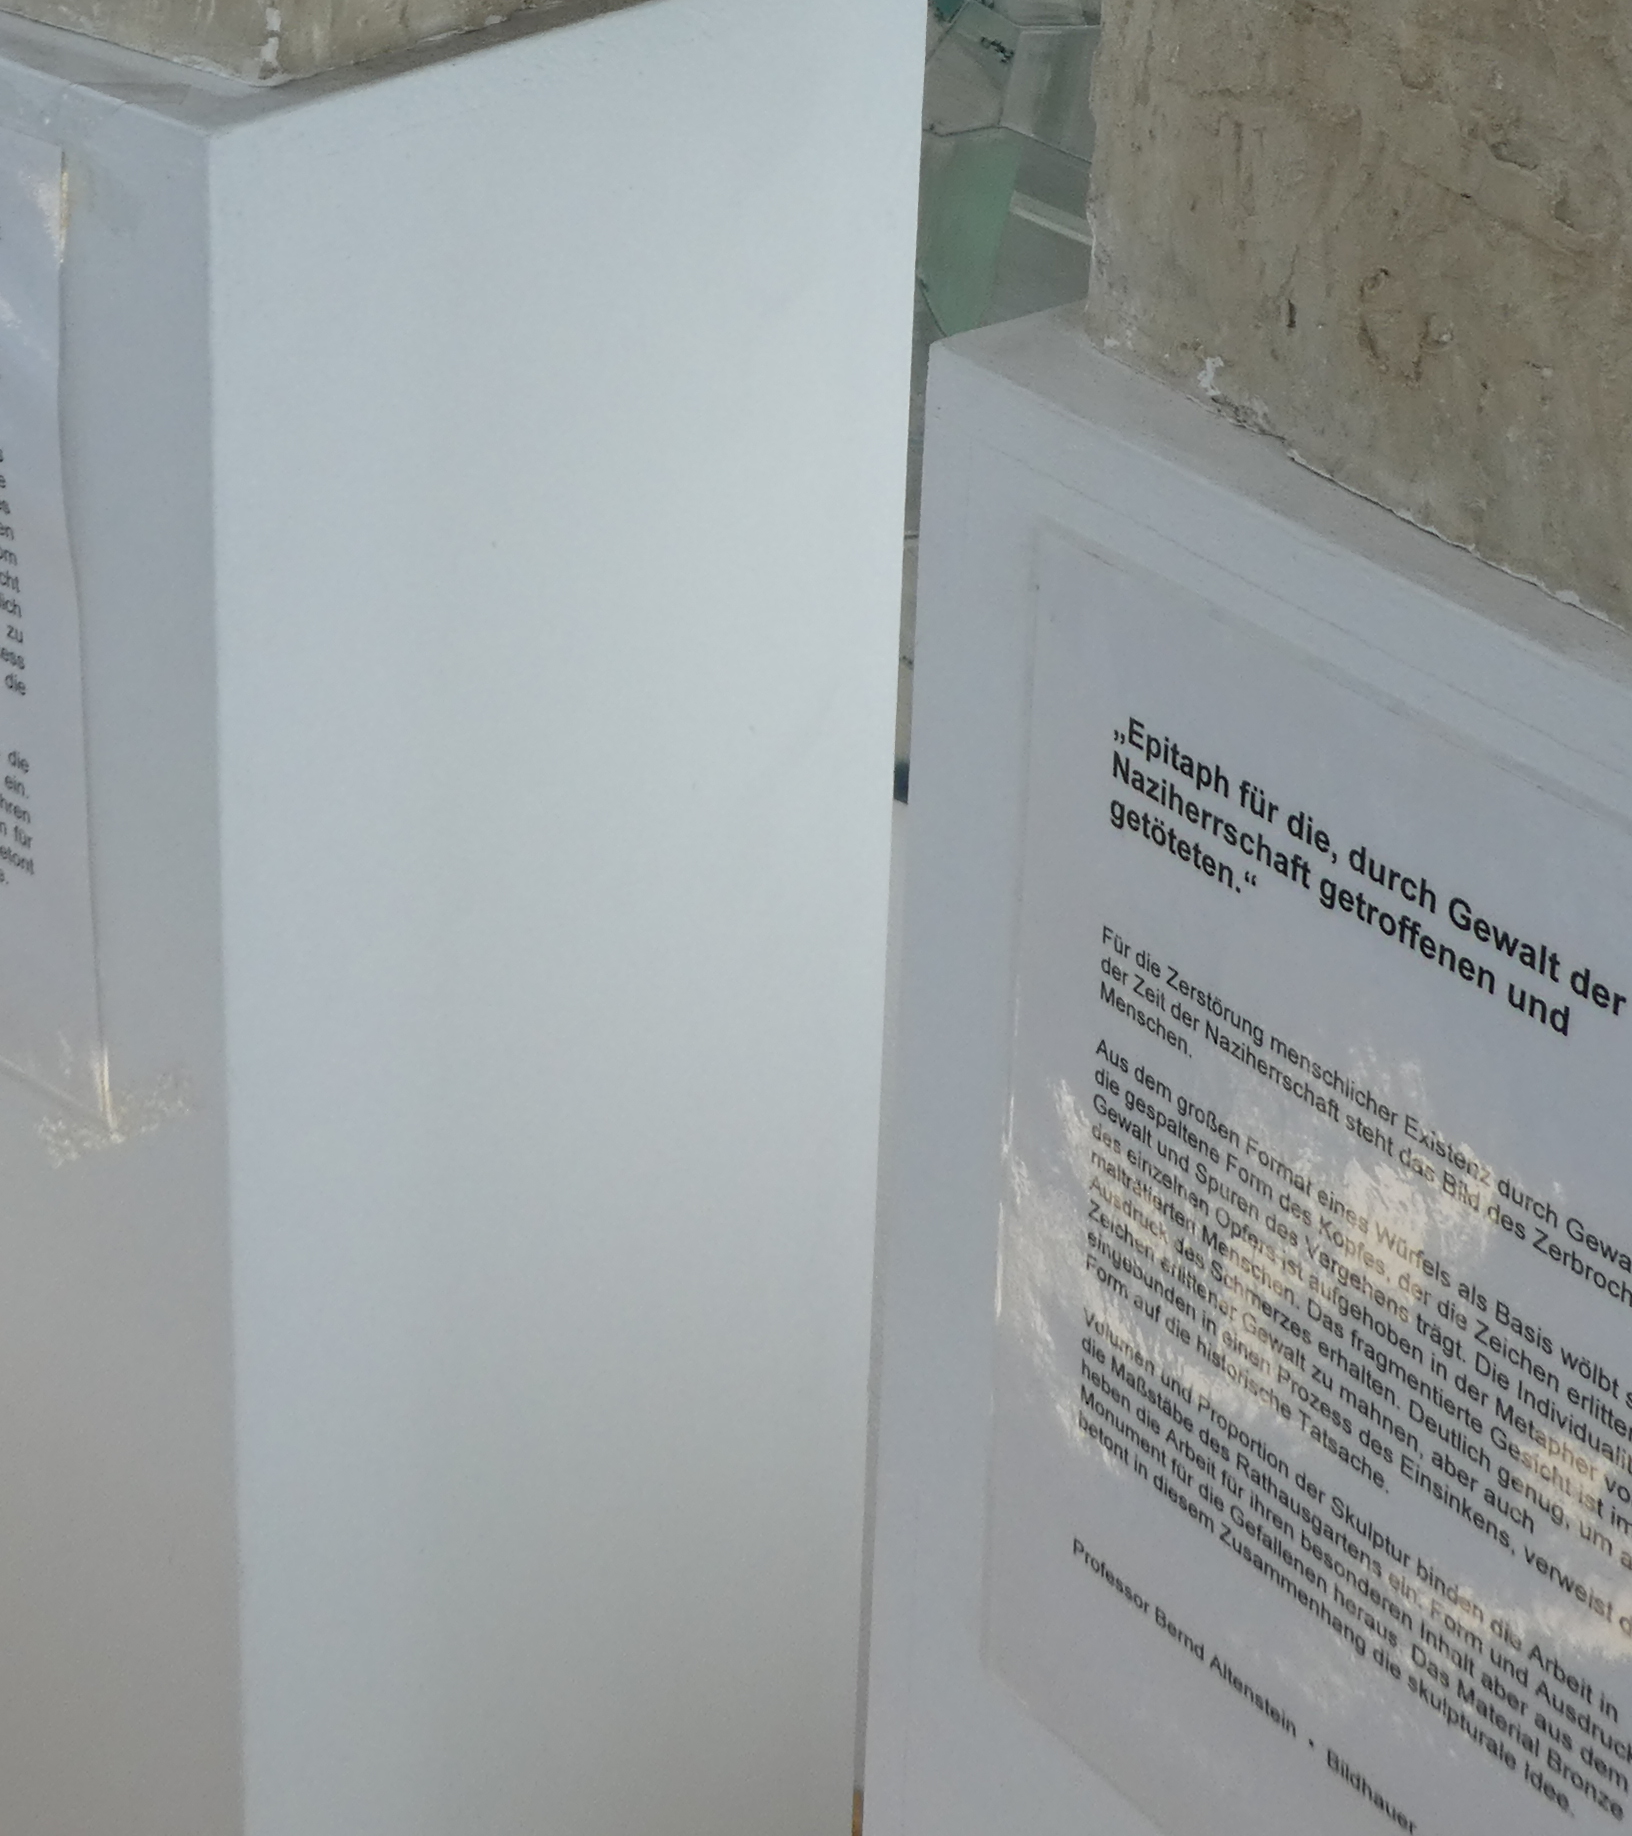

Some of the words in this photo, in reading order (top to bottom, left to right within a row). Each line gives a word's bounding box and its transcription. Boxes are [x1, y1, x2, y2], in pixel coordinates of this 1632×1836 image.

[1109, 799, 1257, 893] getöteten.“
[1112, 751, 1310, 887] Naziherrschaft
[1319, 878, 1495, 994] getroffenen
[1506, 982, 1571, 1037] und
[1113, 716, 1230, 798] „Epitaph
[1238, 779, 1280, 824] für
[1286, 810, 1338, 864] die,
[1348, 845, 1437, 914] durch
[1448, 896, 1560, 983] Gewalt
[1569, 967, 1628, 1017] der
[1099, 981, 1192, 1057] Menschen.
[1100, 956, 1129, 986] der
[1132, 972, 1166, 1012] Zeit
[1169, 1001, 1201, 1032] der
[1204, 1019, 1340, 1122] Naziherrschaft
[1345, 1114, 1394, 1158] steht
[1398, 1146, 1435, 1182] das
[1441, 1169, 1480, 1213] Bild
[1486, 1203, 1527, 1241] des
[1101, 924, 1132, 959] Für
[1134, 949, 1162, 979] die
[1165, 965, 1264, 1047] Zerstörung
[1269, 1035, 1399, 1126] menschlicher
[1403, 1113, 1490, 1185] Existenz
[1496, 1178, 1558, 1229] durch
[1092, 1093, 1152, 1148] Gewalt
[1156, 1139, 1190, 1174] und
[1194, 1162, 1259, 1220] Spuren
[1264, 1213, 1298, 1247] des
[1415, 1312, 1466, 1363] trägt.
[1474, 1350, 1510, 1391] Die
[1093, 1067, 1120, 1097] die
[1124, 1089, 1220, 1164] gespaltene
[1225, 1151, 1273, 1202] Form
[1278, 1192, 1312, 1227] des
[1397, 1272, 1432, 1307] der
[1436, 1299, 1468, 1332] die
[1473, 1318, 1560, 1393] Zeichen
[1094, 1037, 1129, 1074] Aus
[1133, 1064, 1172, 1103] dem
[1176, 1095, 1240, 1148] großen
[1245, 1134, 1313, 1196] Format
[1375, 1221, 1451, 1288] Würfels
[1457, 1281, 1488, 1313] als
[1494, 1299, 1553, 1355] Basis
[1559, 1346, 1619, 1400] wölbt
[1306, 1297, 1344, 1339] Das
[1350, 1329, 1483, 1434] fragmentierte
[1080, 1335, 1106, 1365] die
[1110, 1355, 1194, 1434] Maßstäbe
[1198, 1427, 1230, 1462] des
[1235, 1452, 1382, 1578] Rathausgartens
[1489, 1647, 1529, 1689] und
[1132, 1294, 1162, 1324] auf
[1298, 1408, 1389, 1494] Tatsache.
[1201, 1309, 1217, 1337] in
[1276, 1364, 1352, 1435] Prozess
[1358, 1428, 1394, 1464] des
[1399, 1453, 1515, 1556] Einsinkens,
[1308, 1274, 1424, 1364] aufgehoben
[1429, 1351, 1448, 1382] in
[1453, 1373, 1489, 1407] der
[1494, 1396, 1594, 1480] Metapher
[1310, 1363, 1334, 1392] zu
[1338, 1384, 1423, 1459] mahnen,
[1430, 1450, 1479, 1492] aber
[1483, 1487, 1535, 1535] auch
[1317, 1340, 1400, 1410] erhalten.
[1408, 1398, 1491, 1472] Deutlich
[1496, 1465, 1570, 1531] genug,
[1072, 1536, 1150, 1615] Professor
[1154, 1605, 1205, 1663] Bernd
[1209, 1654, 1297, 1738] Altenstein
[1325, 1747, 1416, 1836] Bildhauer
[1079, 1383, 1166, 1468] Monument
[1170, 1456, 1194, 1488] für
[1197, 1482, 1225, 1513] die
[1229, 1504, 1327, 1593] Gefallenen
[1410, 1642, 1450, 1689] Das
[1456, 1678, 1540, 1757] Material
[1546, 1746, 1624, 1821] Bronze
[1080, 1357, 1131, 1413] heben
[1135, 1405, 1161, 1436] die
[1165, 1428, 1216, 1480] Arbeit
[1220, 1468, 1245, 1499] für
[1249, 1489, 1294, 1540] ihren
[1300, 1529, 1413, 1631] besonderen
[1419, 1618, 1475, 1678] Inhalt
[1480, 1671, 1529, 1716] aber
[1533, 1712, 1573, 1752] aus
[1579, 1745, 1629, 1795] dem
[1133, 1452, 1149, 1481] in
[1152, 1474, 1215, 1534] diesem
[1219, 1522, 1366, 1657] Zusammenhang
[1371, 1647, 1402, 1681] die
[1407, 1675, 1517, 1772] skulpturale
[1523, 1760, 1574, 1818] Idee.
[1197, 1394, 1289, 1479] Proportion
[1293, 1470, 1327, 1504] der
[1330, 1495, 1411, 1568] Skulptur
[1415, 1556, 1484, 1622] binden
[1526, 1643, 1593, 1705] Arbeit
[1598, 1690, 1619, 1724] in
